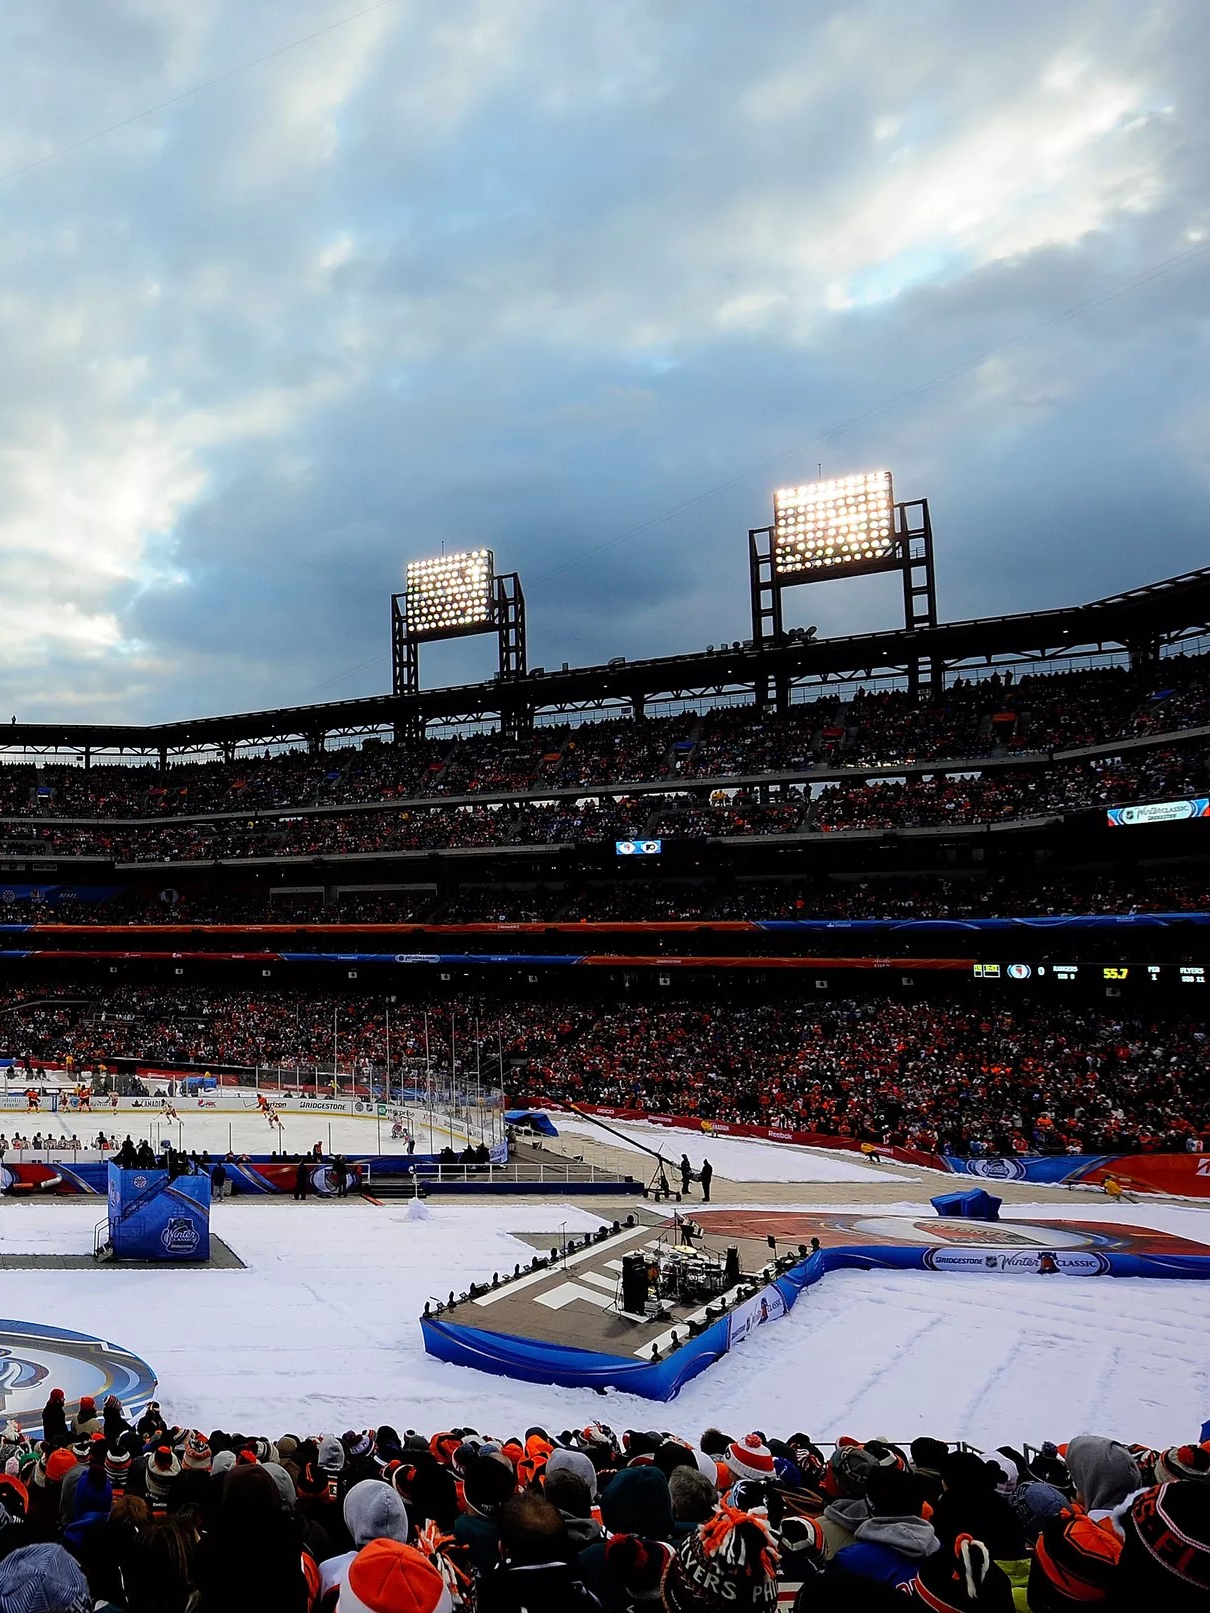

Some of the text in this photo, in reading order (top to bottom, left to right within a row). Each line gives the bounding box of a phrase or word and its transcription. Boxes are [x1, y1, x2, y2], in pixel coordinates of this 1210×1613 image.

[1103, 968, 1128, 979] 55.7
[299, 1101, 346, 1111] BRIDGESTONE
[768, 1130, 793, 1140] Reebok
[168, 1224, 196, 1239] Winter
[935, 1251, 1097, 1270] BRIDGESTONE Winter CLASSIC
[767, 1299, 782, 1313] CLASSIC
